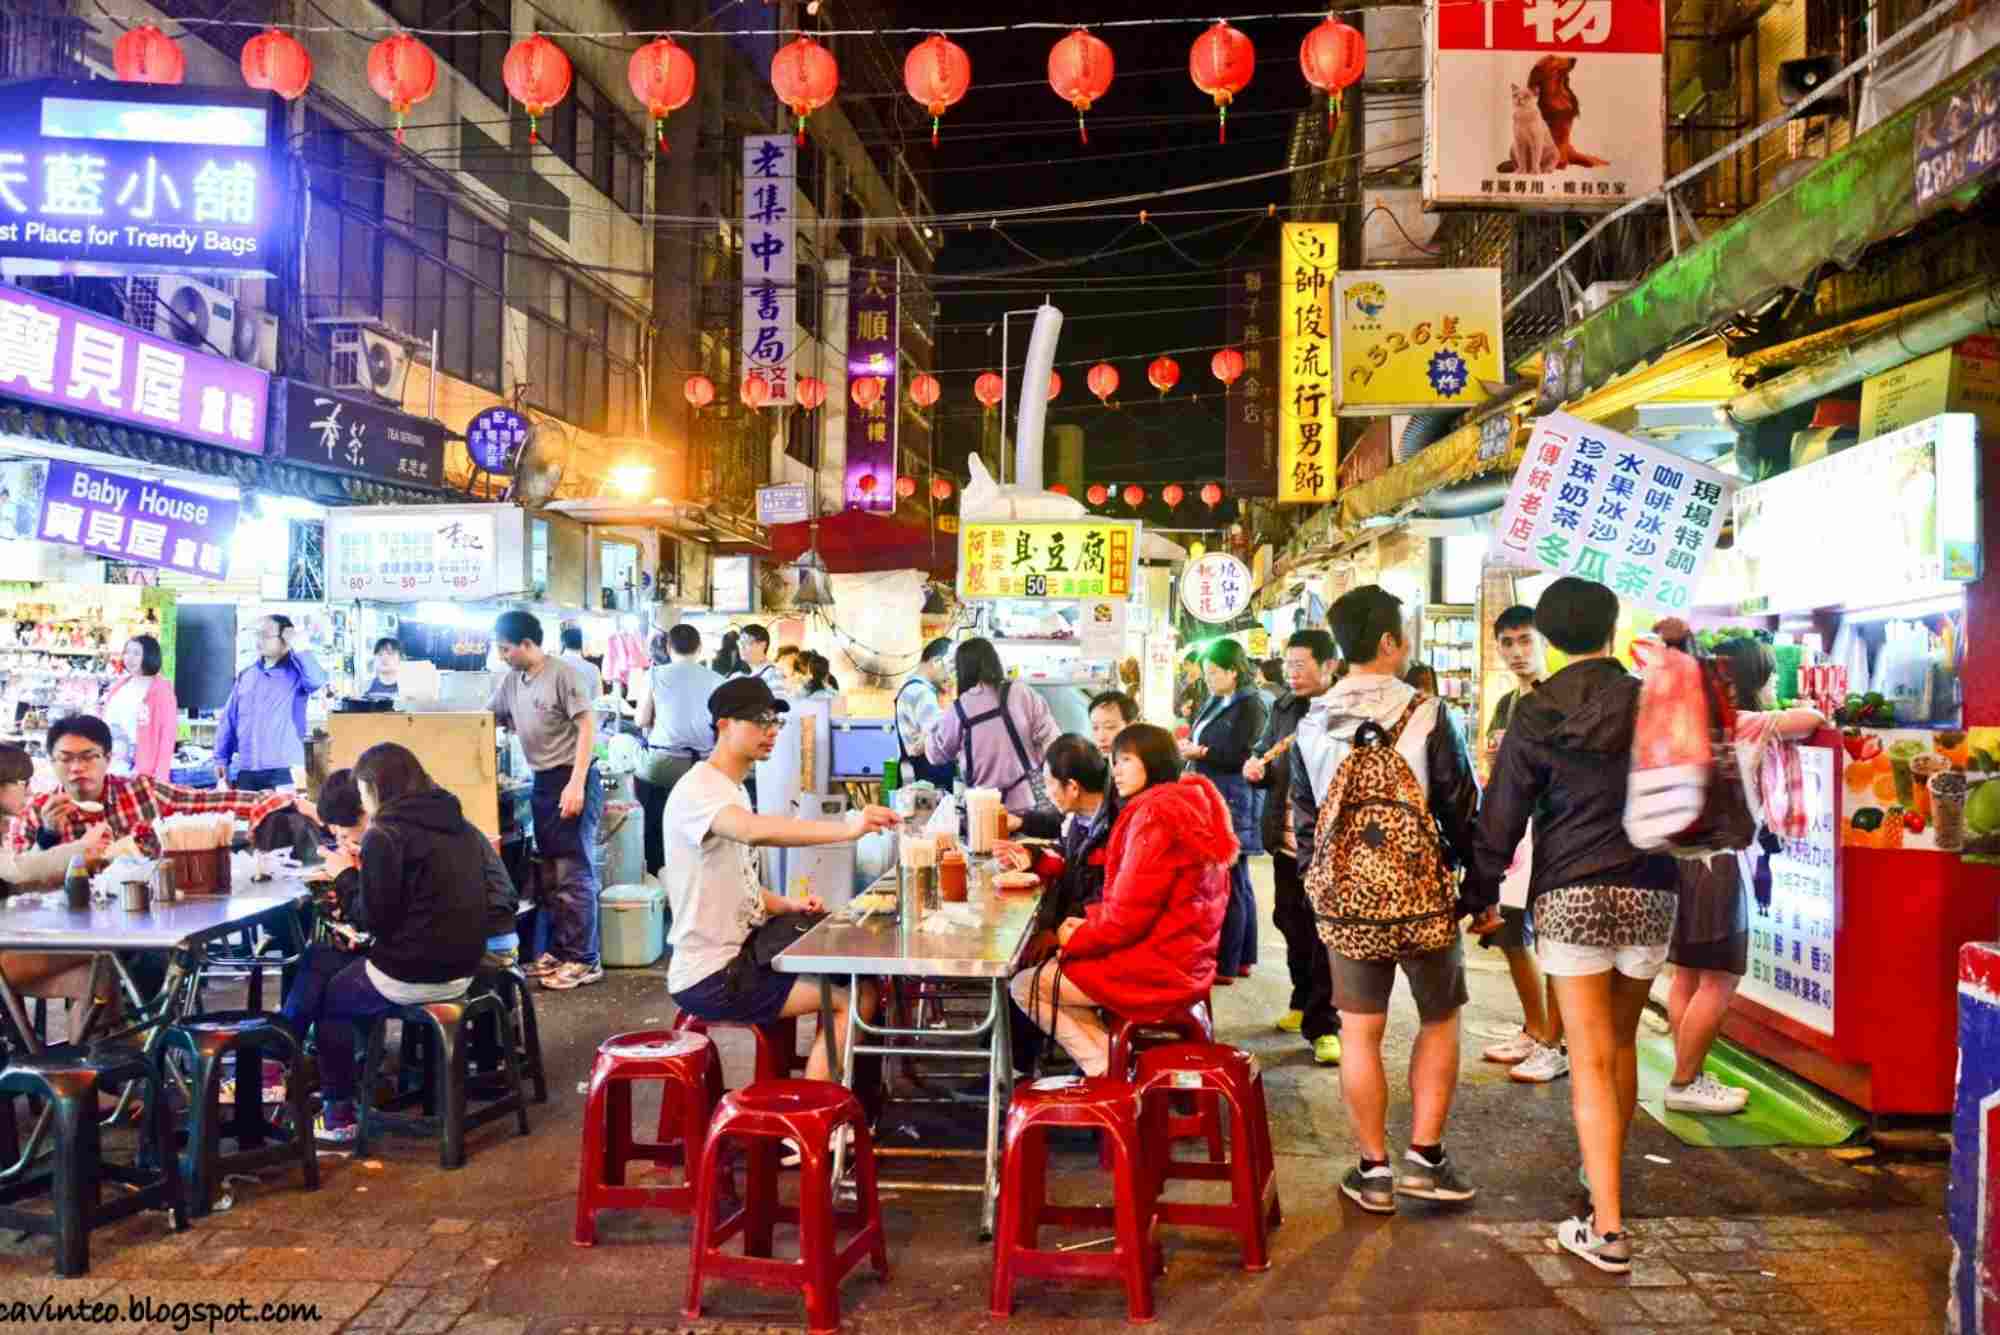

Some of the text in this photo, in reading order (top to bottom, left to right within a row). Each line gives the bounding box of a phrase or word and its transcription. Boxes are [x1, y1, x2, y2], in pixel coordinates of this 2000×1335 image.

[25, 221, 82, 244] Place
[88, 224, 118, 246] for
[125, 226, 198, 255] Trendy
[203, 230, 258, 257] Bags
[749, 140, 786, 365] 老集中書局
[71, 471, 209, 526] Baby House
[1552, 436, 1607, 531] 珍珠奶茶
[1587, 453, 1644, 542] 水果冰沙
[1626, 465, 1684, 557] 咖啡冰沙
[42, 500, 168, 561] 寶貝屋
[1011, 530, 1105, 574] 臭豆腐
[1665, 479, 1722, 575] 現場特調
[1574, 1229, 1588, 1245] N
